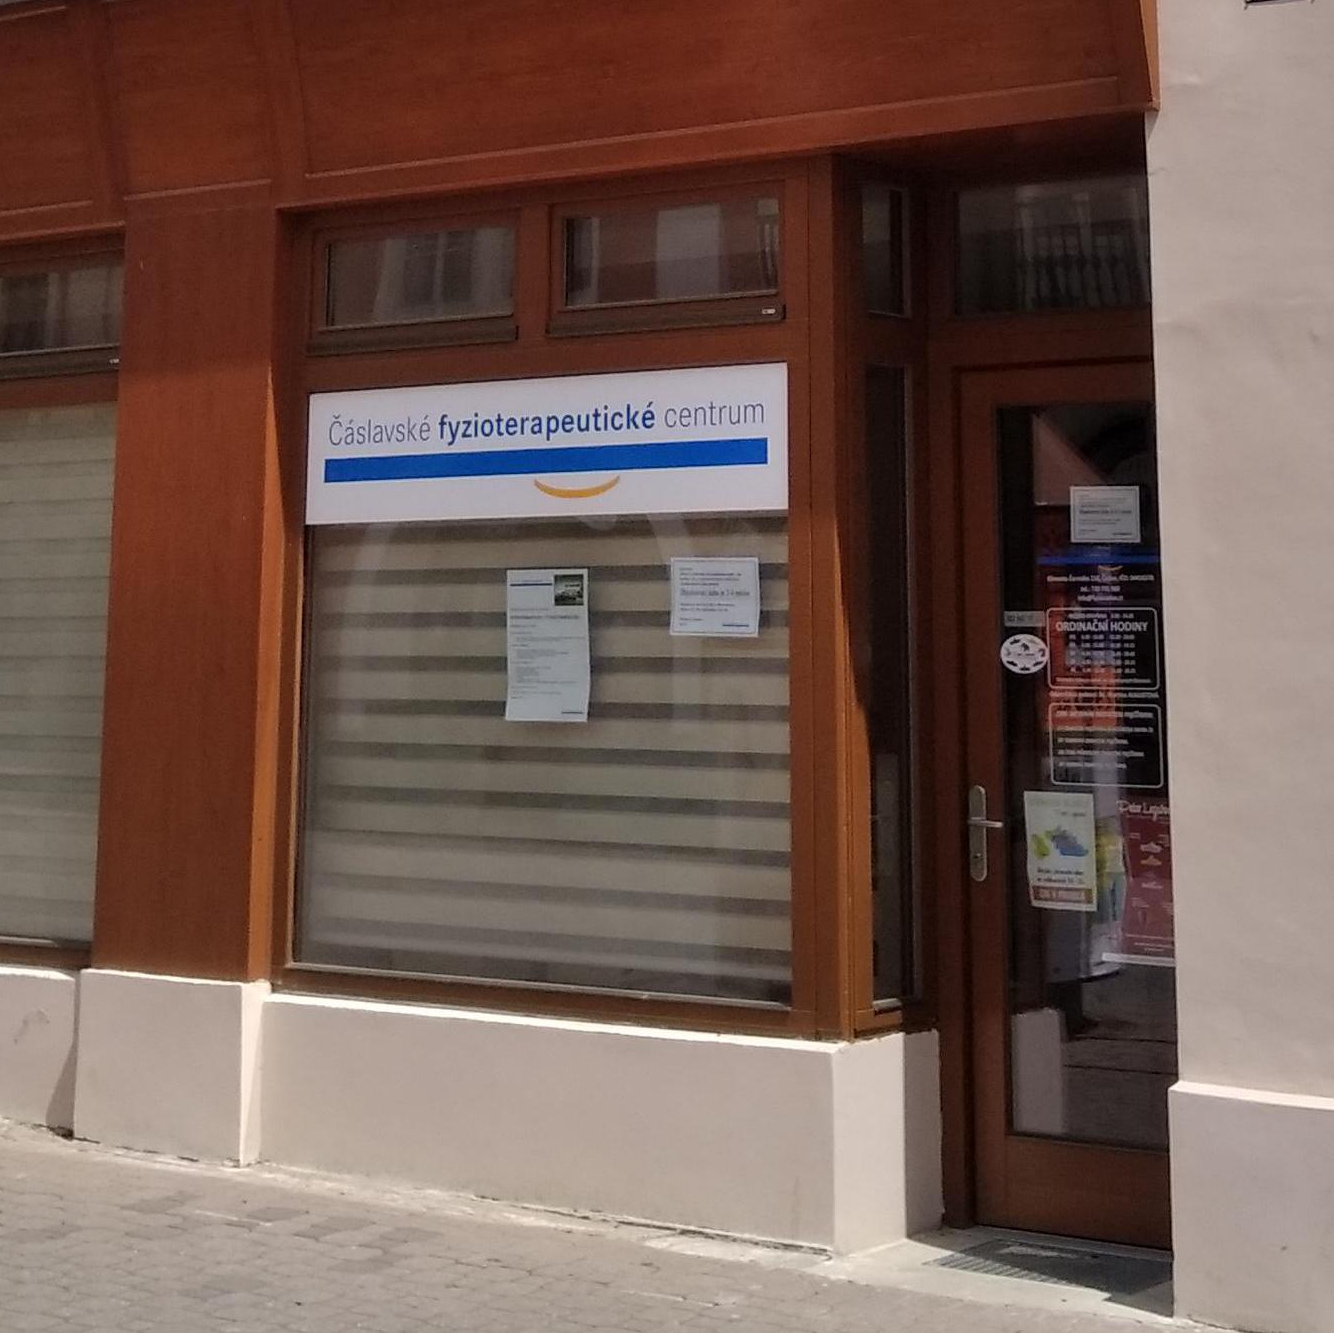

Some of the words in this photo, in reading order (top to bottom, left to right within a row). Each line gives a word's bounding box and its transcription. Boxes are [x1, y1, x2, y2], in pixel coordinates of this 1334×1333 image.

[328, 413, 432, 446] Čáslavské
[438, 401, 656, 446] fyzioterapeutické
[664, 401, 766, 428] centrum
[1055, 619, 1108, 632] ORDINAČNÍ
[1110, 621, 1148, 632] HODINY
